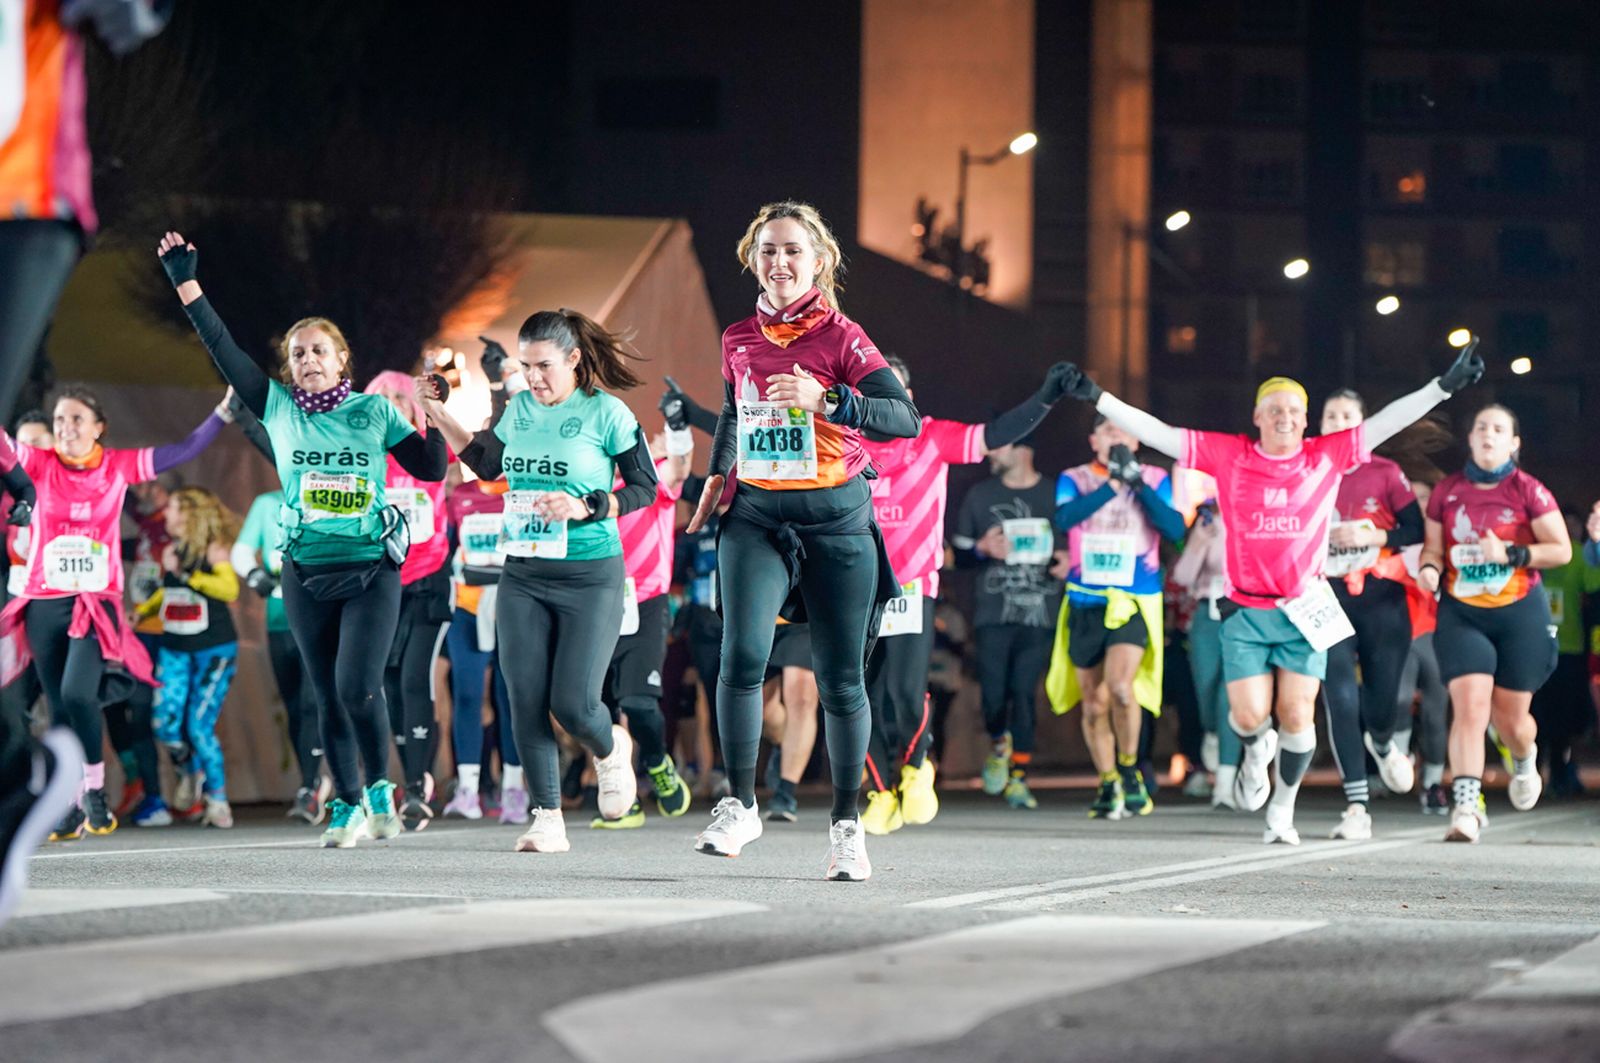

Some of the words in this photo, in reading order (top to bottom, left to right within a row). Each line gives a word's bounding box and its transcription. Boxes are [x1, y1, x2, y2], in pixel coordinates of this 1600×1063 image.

[749, 428, 803, 452] 12138
[292, 446, 369, 467] serás
[504, 455, 568, 477] serás
[310, 489, 367, 508] 13905
[59, 557, 93, 573] 3115
